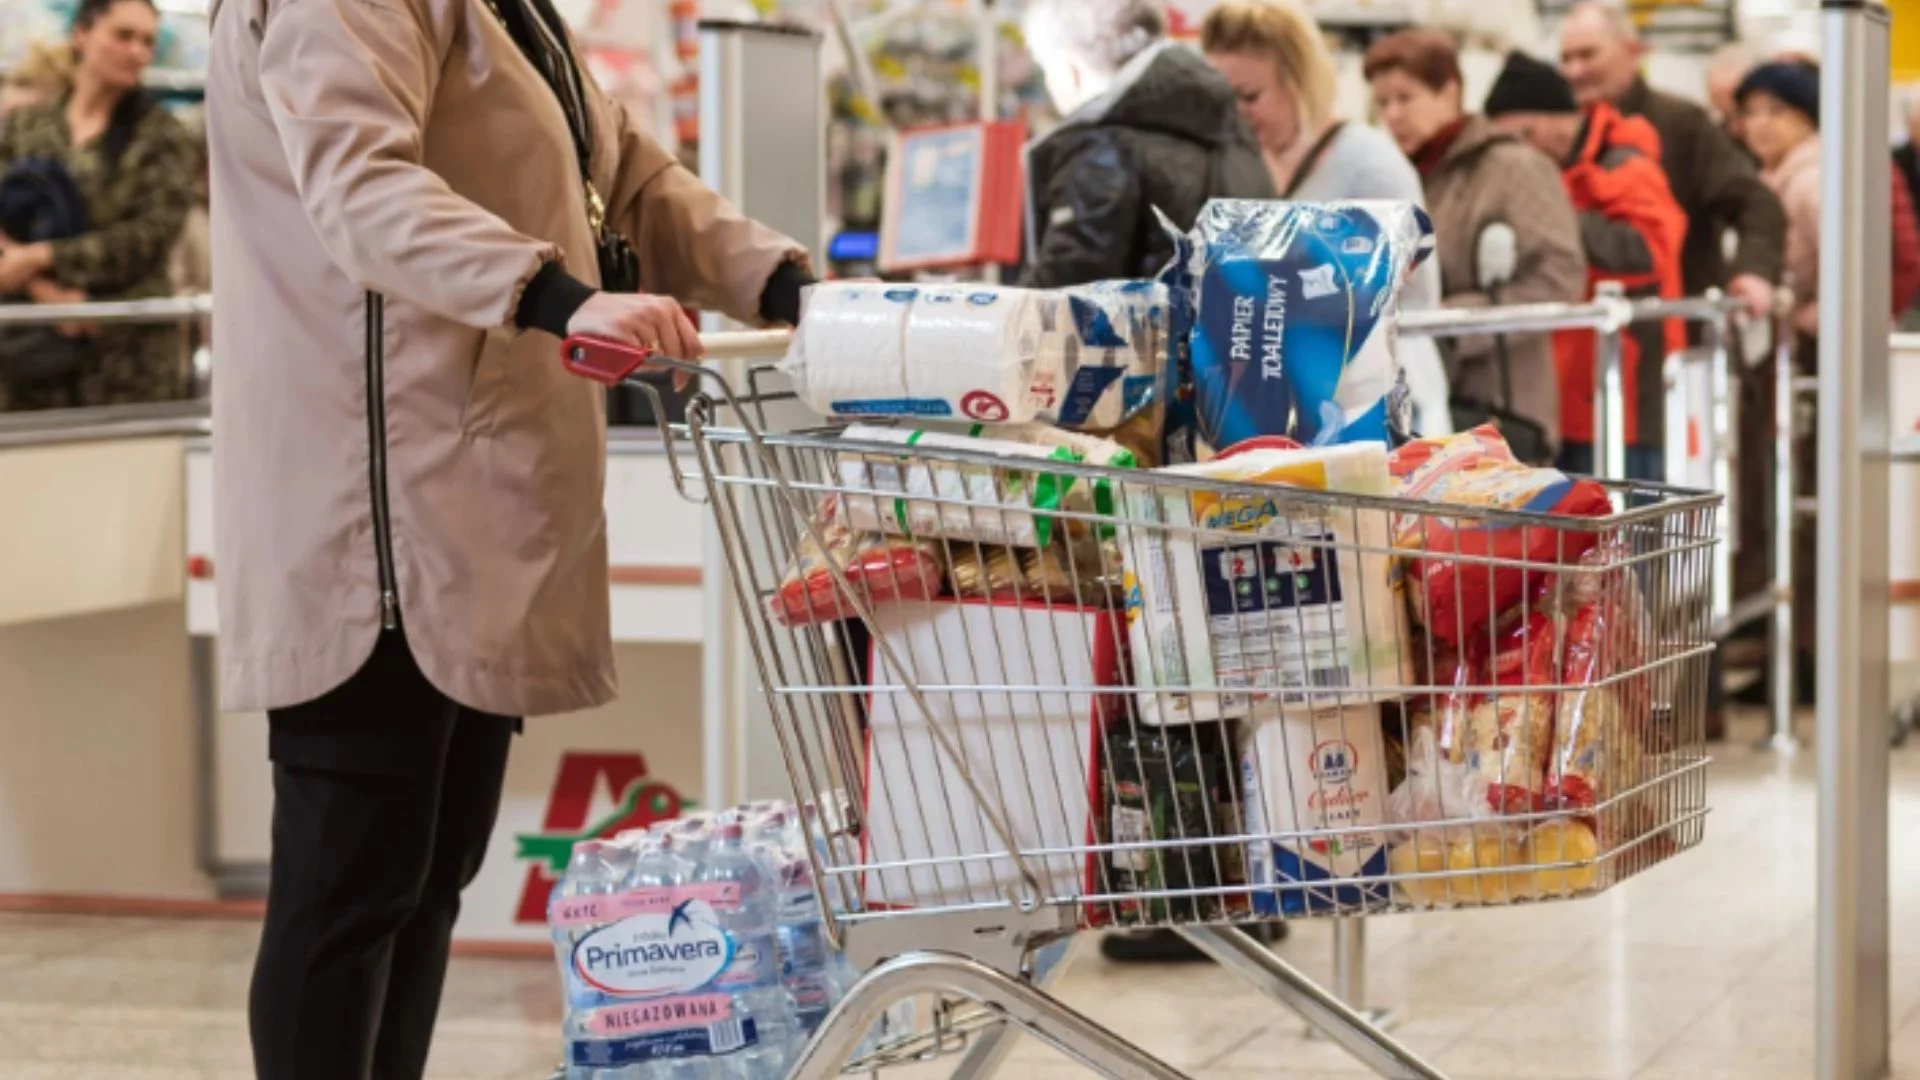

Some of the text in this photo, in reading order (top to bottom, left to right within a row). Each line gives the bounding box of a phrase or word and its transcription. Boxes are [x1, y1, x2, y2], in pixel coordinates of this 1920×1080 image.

[1229, 296, 1255, 360] PAPIER
[1261, 274, 1288, 381] TOALETOWY
[1207, 498, 1279, 528] MEGA
[587, 939, 719, 970] Primavera
[604, 1001, 718, 1029] NIEGAZOWANA
